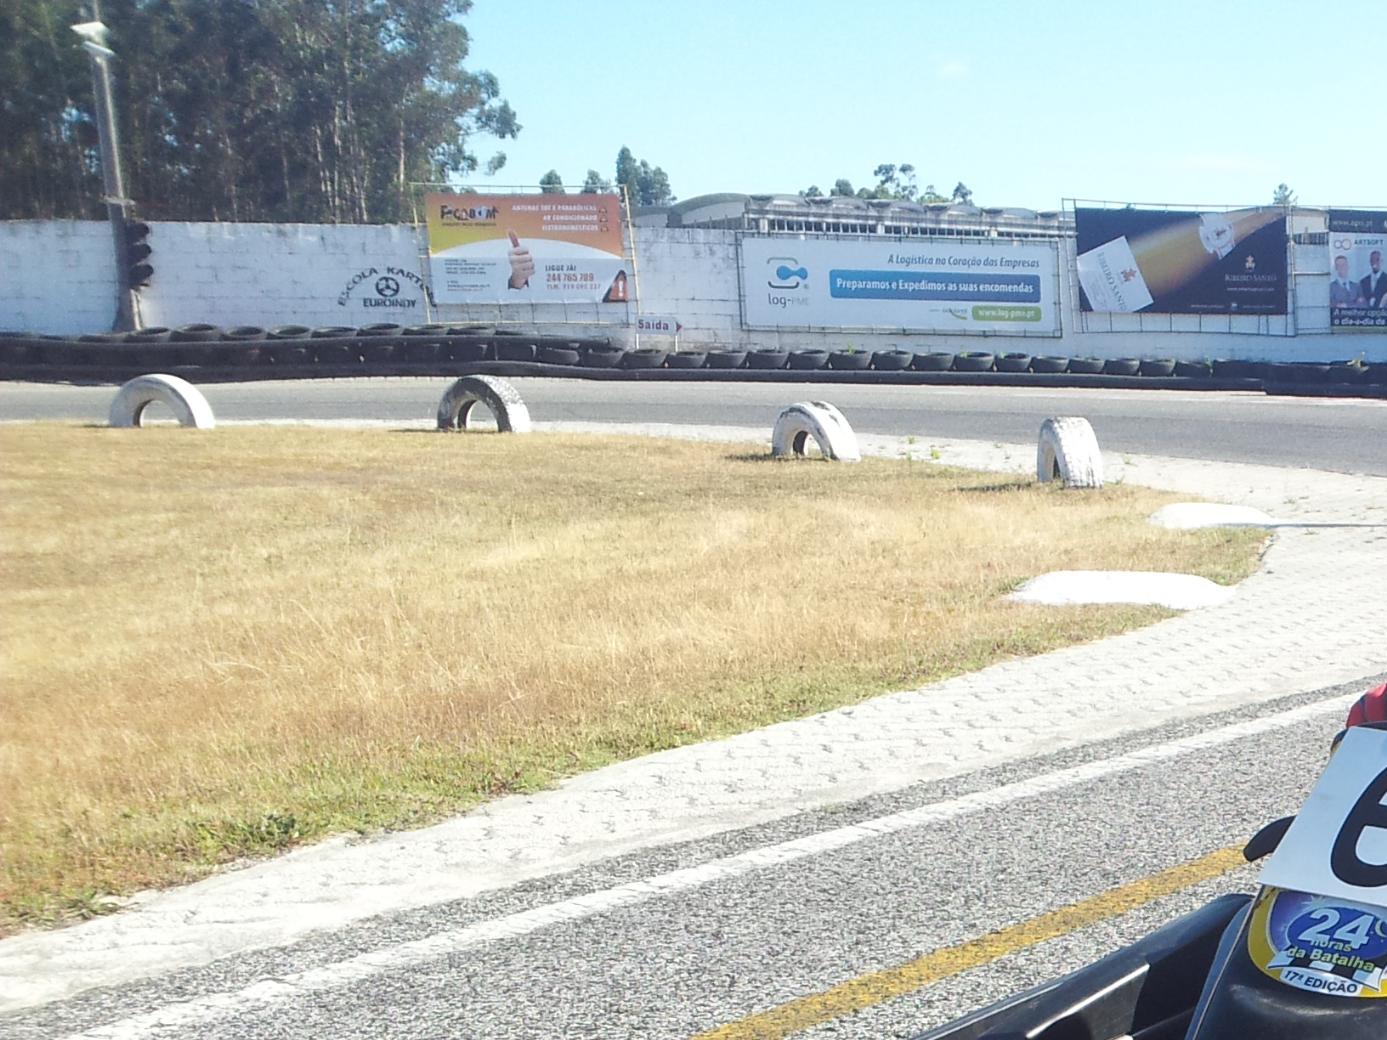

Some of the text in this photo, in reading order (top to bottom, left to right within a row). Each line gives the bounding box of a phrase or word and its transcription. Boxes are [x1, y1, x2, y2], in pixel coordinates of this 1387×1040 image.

[888, 254, 894, 264] A
[983, 256, 998, 267] das
[1000, 257, 1040, 269] Empresas
[337, 267, 378, 307] ESCOLA
[837, 278, 1034, 293] Preparamos e Expedimos as suas encomendas
[363, 298, 416, 308] EUROINDY
[1297, 908, 1375, 949] 24
[1287, 946, 1375, 972] da Batalha
[1304, 976, 1358, 993] EDIÇÃO
